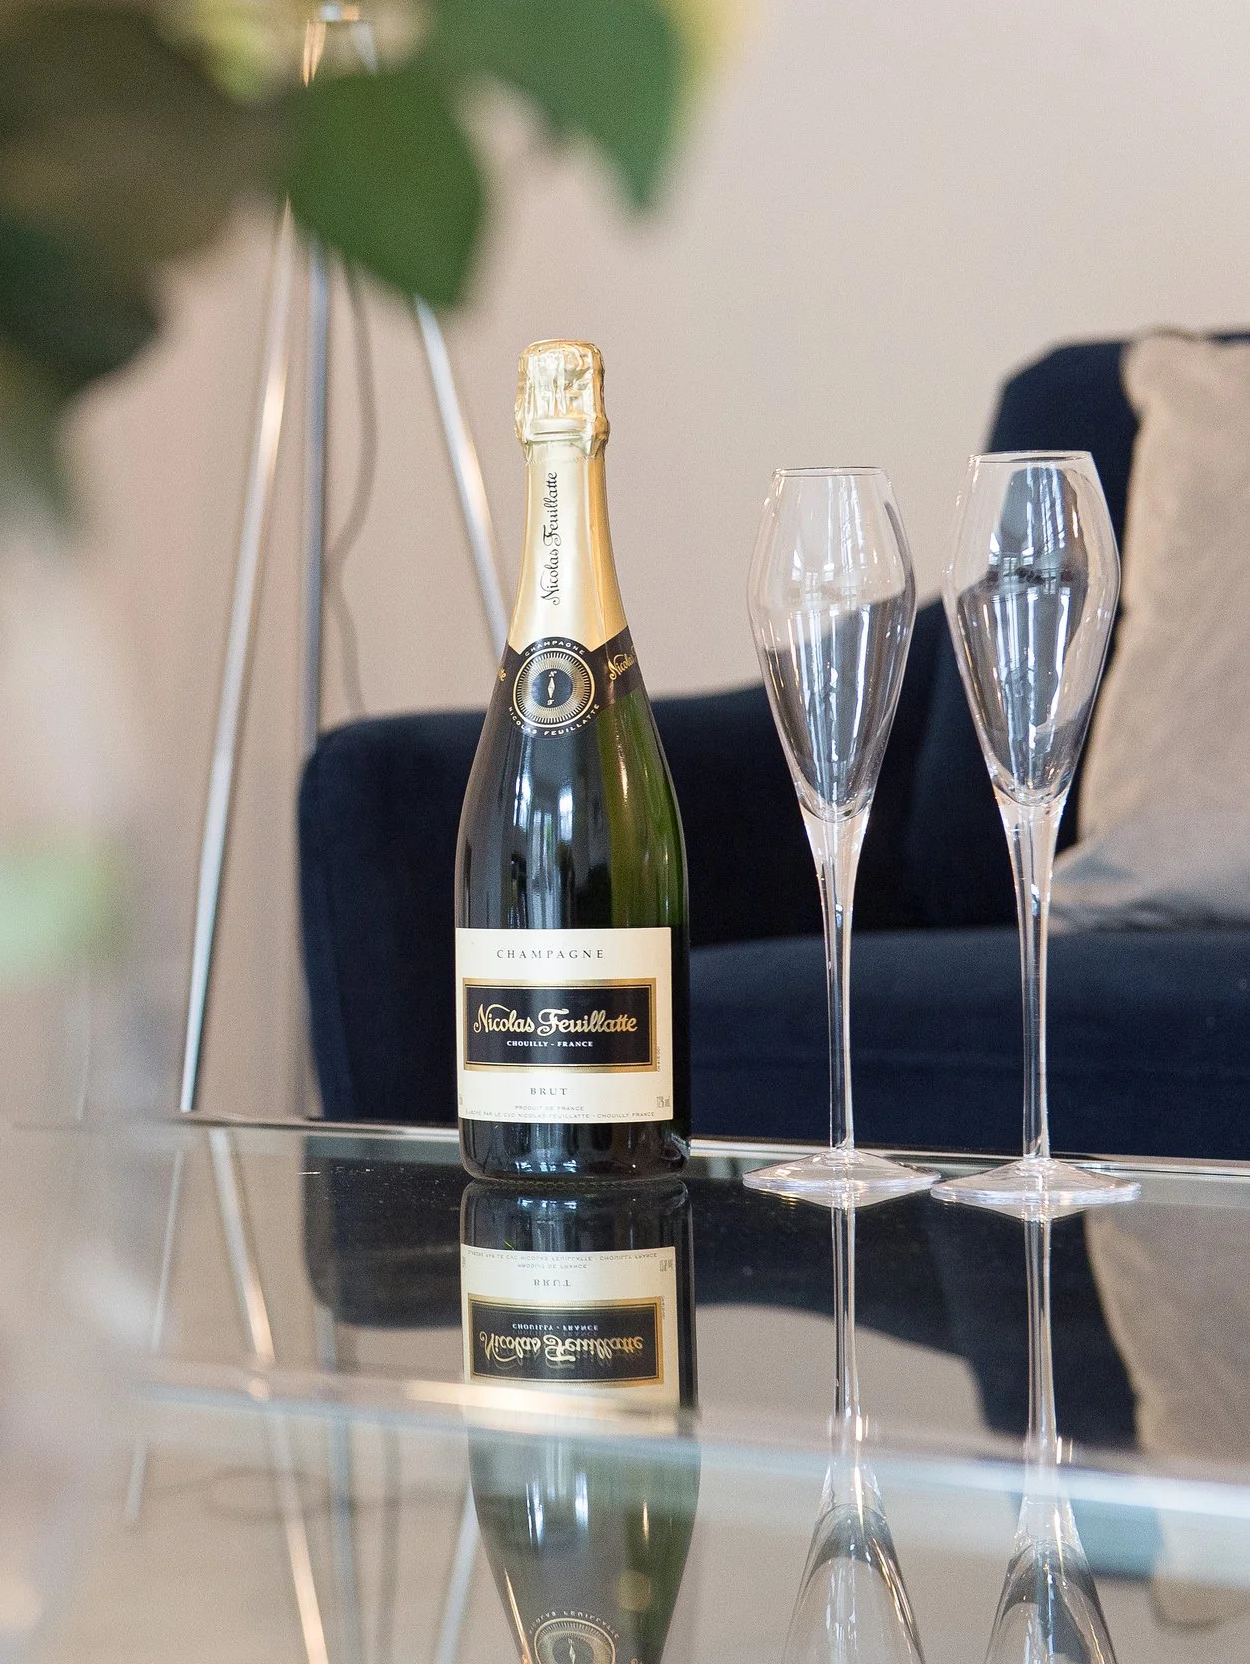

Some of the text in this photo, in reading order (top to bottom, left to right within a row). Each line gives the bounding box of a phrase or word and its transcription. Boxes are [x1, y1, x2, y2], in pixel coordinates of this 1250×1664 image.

[540, 471, 561, 606] Nicolas Feuillatte
[524, 640, 586, 657] CHAMPAGNE
[543, 703, 600, 736] FEUILLATTE
[496, 949, 605, 959] CHAMPAGNE
[473, 1003, 638, 1037] Nicolas Feuillatte
[530, 1087, 568, 1096] BRUT
